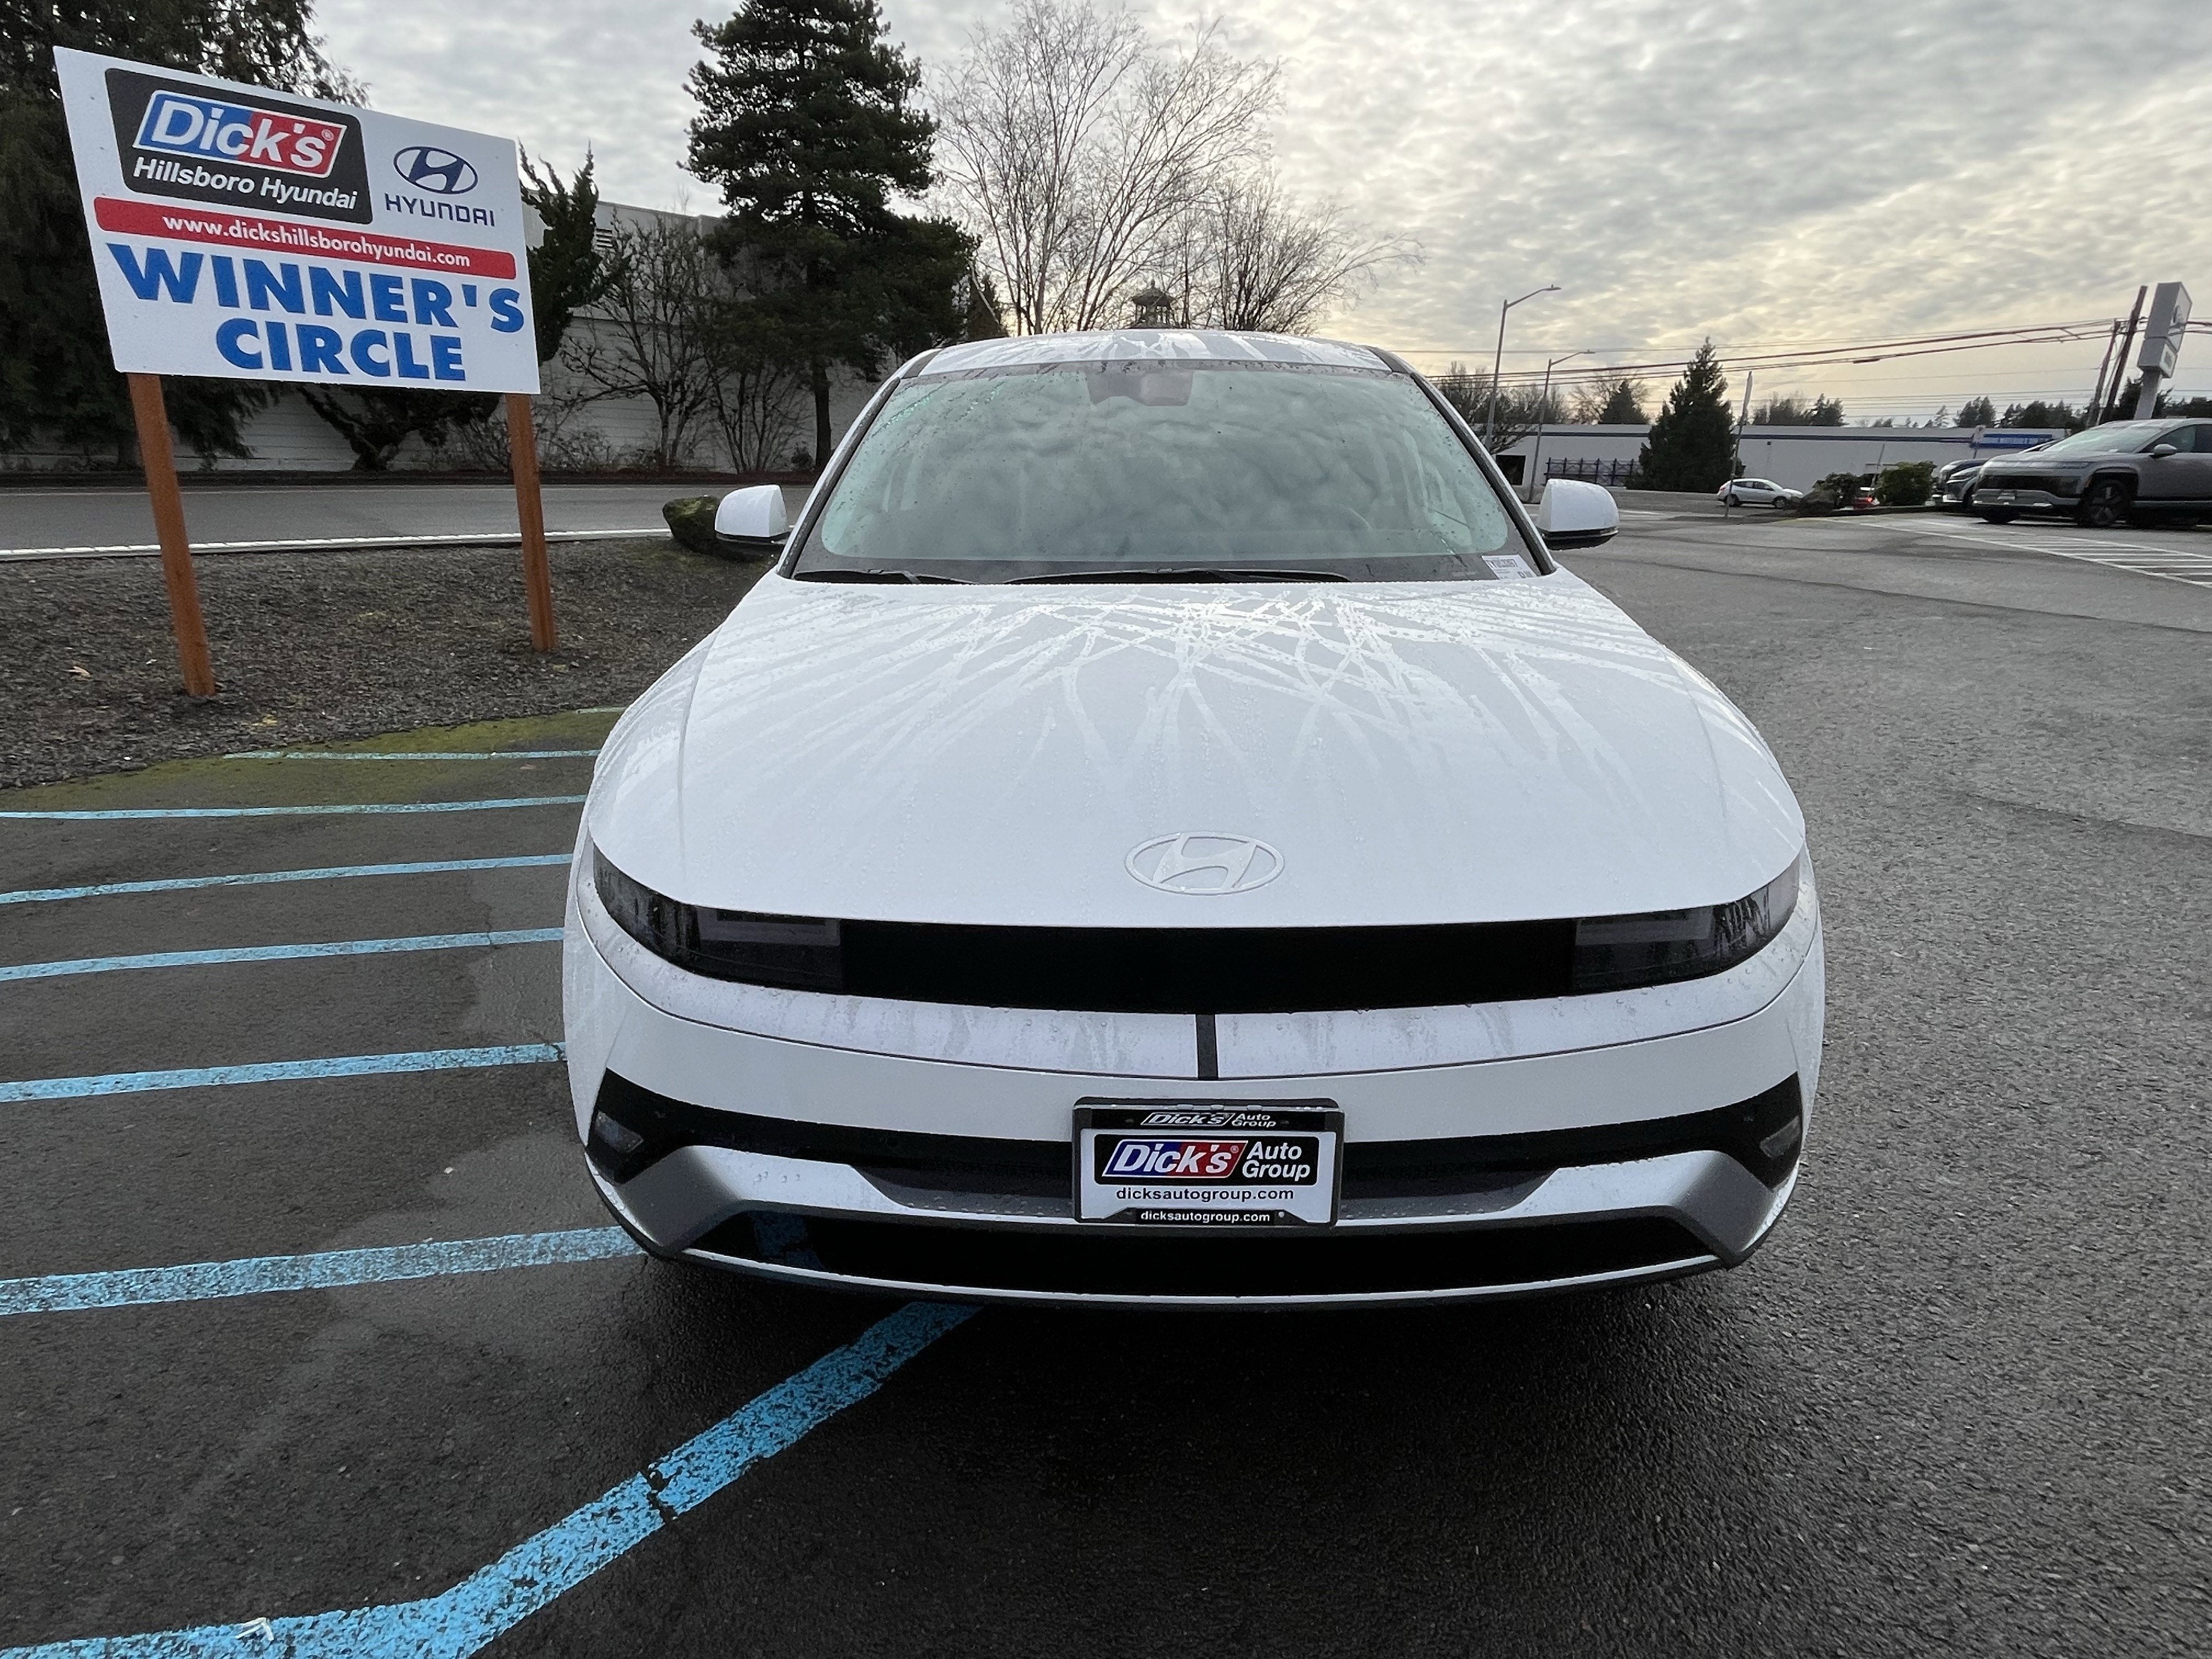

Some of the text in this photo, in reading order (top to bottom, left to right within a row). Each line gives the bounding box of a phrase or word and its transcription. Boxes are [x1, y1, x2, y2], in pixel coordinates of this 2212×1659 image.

[151, 100, 326, 168] Dick's
[133, 157, 358, 210] Hillsboro Hyundai
[384, 193, 495, 227] HYUNDAI
[163, 216, 471, 267] www.dickshillsborohyundai.com
[106, 242, 524, 334] WINNER'S
[216, 318, 466, 381] CIRCLE
[1148, 1114, 1224, 1125] Dick's
[1231, 1120, 1276, 1128] Group
[1113, 1143, 1232, 1173] Dick's
[1246, 1141, 1302, 1160] Auto
[1242, 1160, 1311, 1182] Group
[1116, 1188, 1294, 1203] dicksautogroup.com
[1141, 1210, 1270, 1224] dicksautogroup.com
